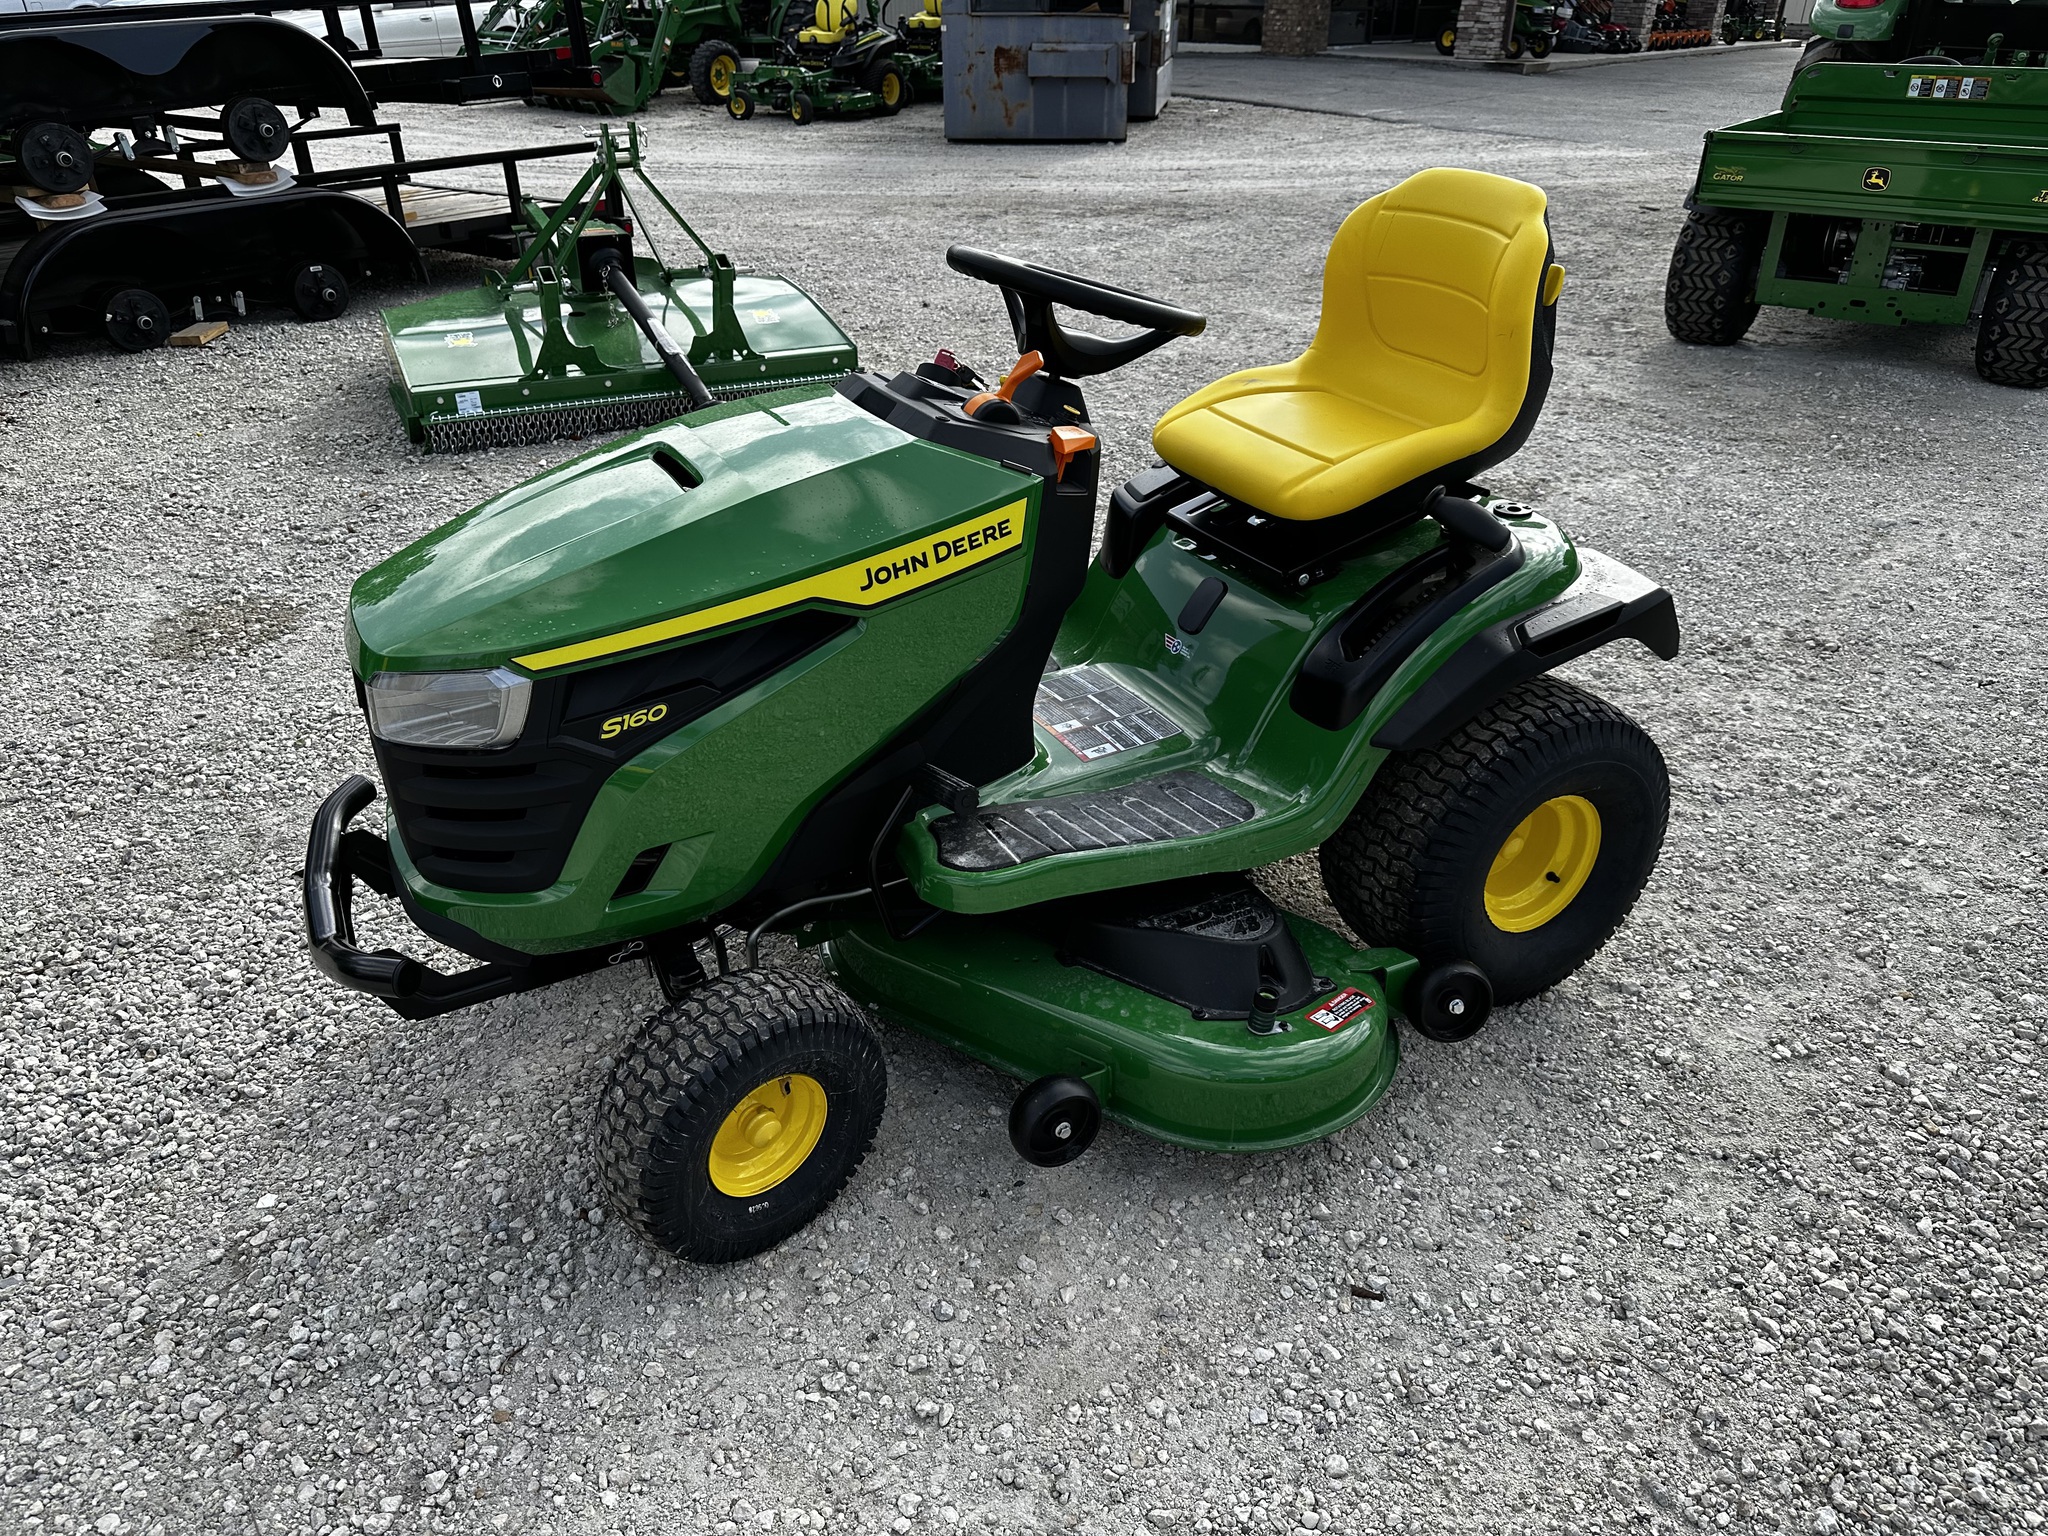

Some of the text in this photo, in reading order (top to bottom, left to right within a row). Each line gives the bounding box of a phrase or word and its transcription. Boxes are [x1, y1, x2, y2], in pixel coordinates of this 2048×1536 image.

[1712, 172, 1744, 182] GATOR
[860, 518, 1013, 592] JOHN DEERE
[600, 703, 668, 740] S160
[1233, 914, 1261, 935] 48
